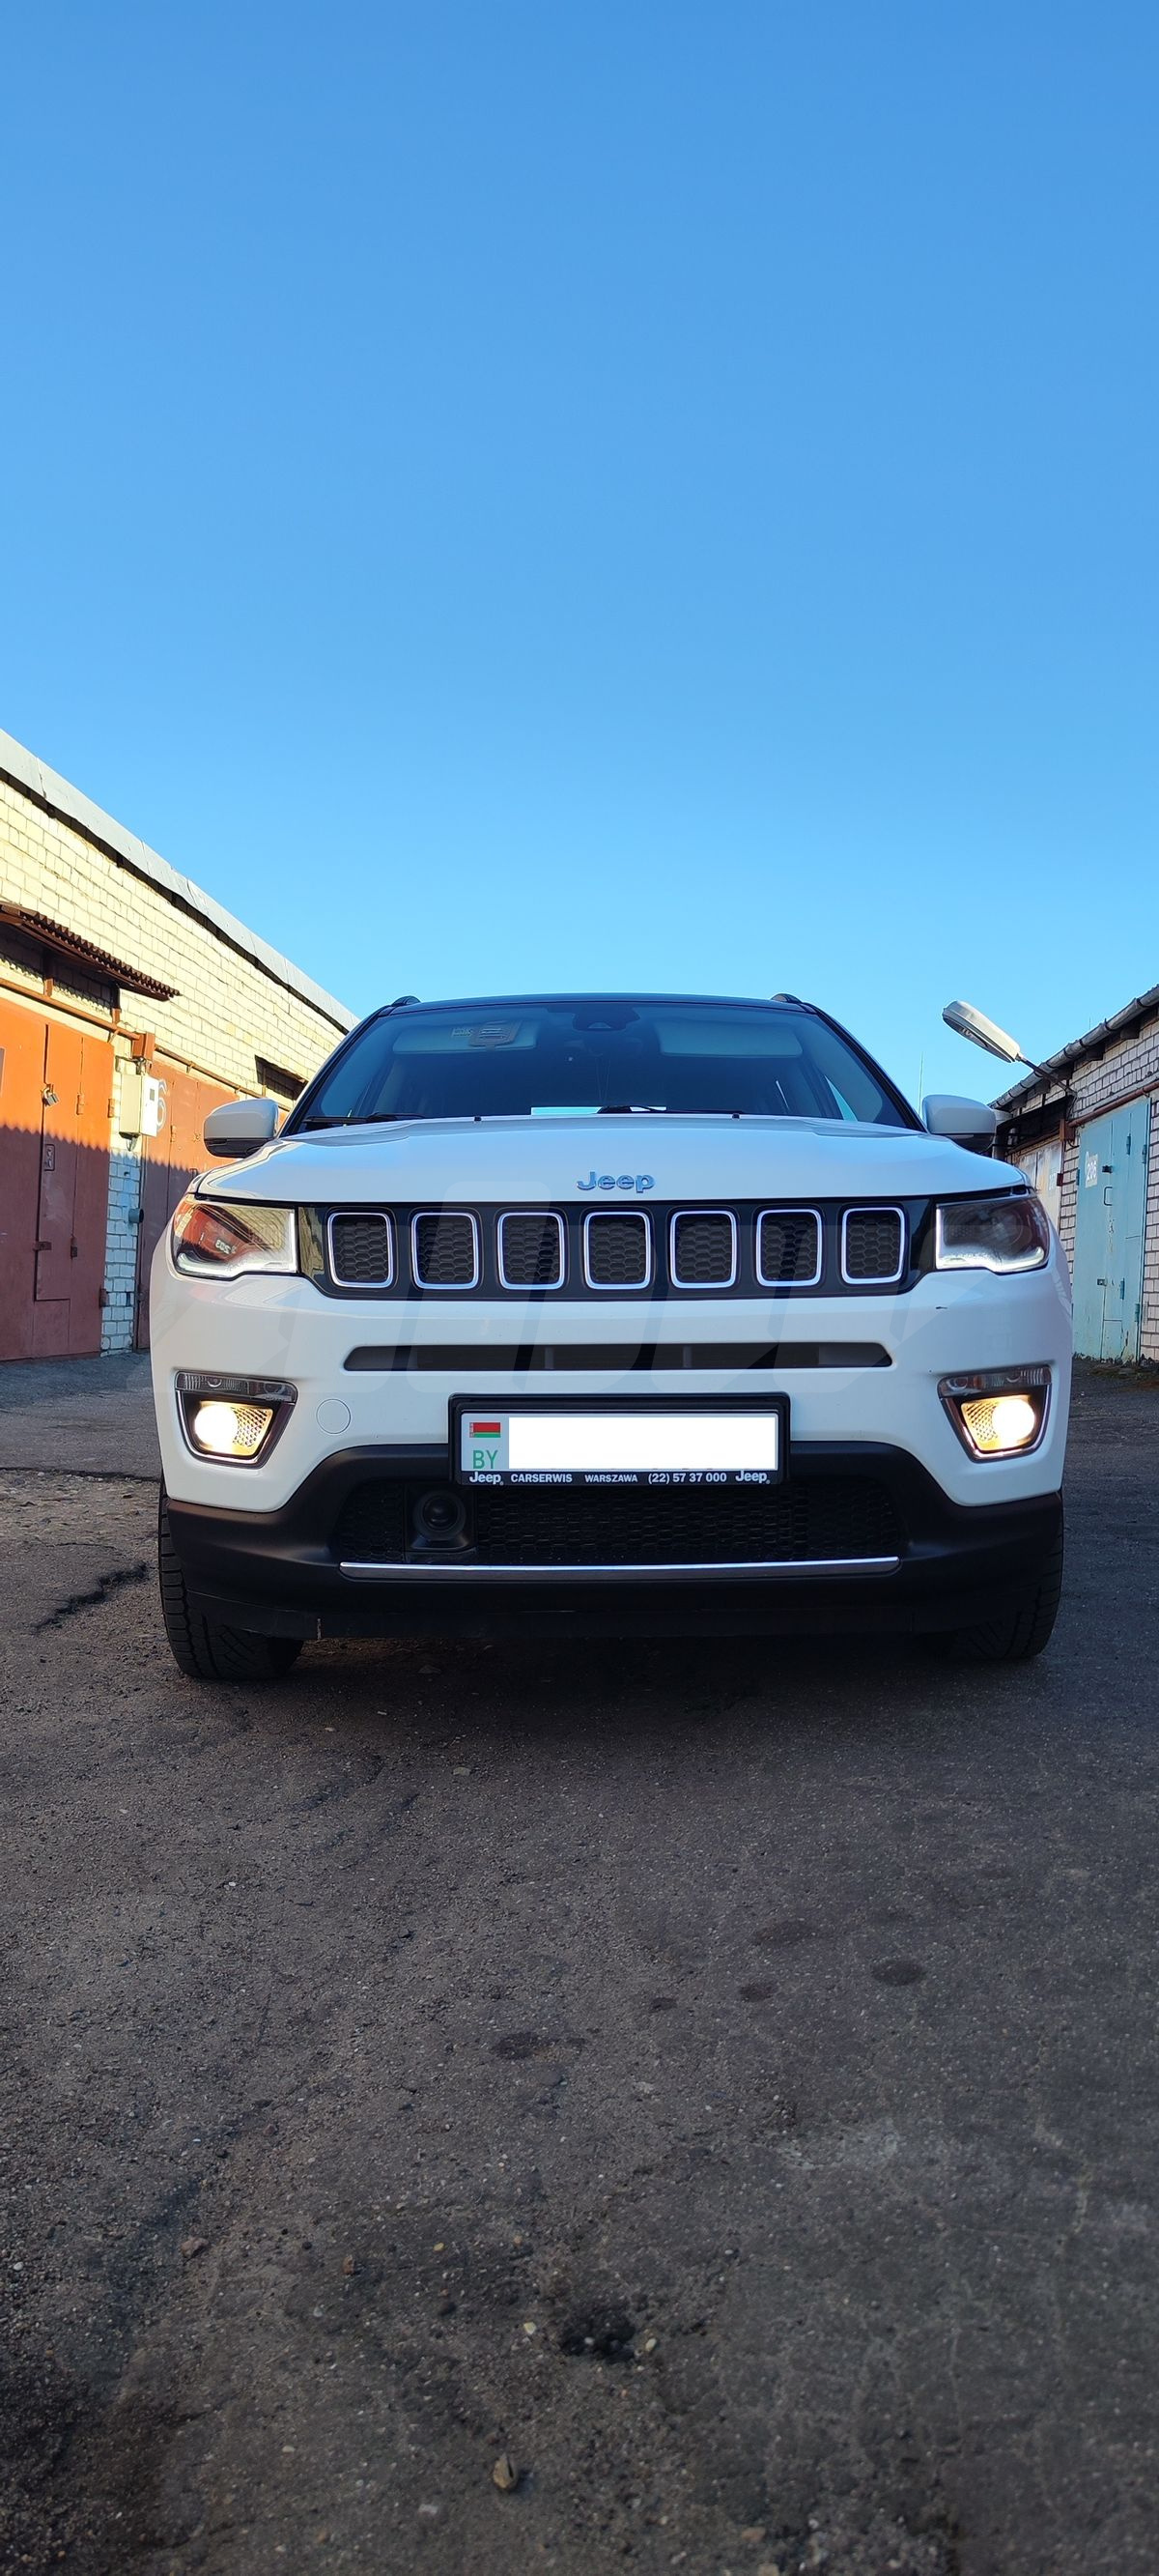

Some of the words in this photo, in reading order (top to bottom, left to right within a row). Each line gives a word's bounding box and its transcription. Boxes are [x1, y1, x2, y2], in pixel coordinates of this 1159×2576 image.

[577, 1170, 656, 1193] Jeep
[472, 1449, 498, 1470] BY
[468, 1471, 502, 1485] Jeep
[510, 1473, 573, 1483] CARSERWIS
[584, 1474, 638, 1483] WARSZAWA
[648, 1473, 670, 1485] (22)
[672, 1473, 687, 1483] 57
[689, 1473, 703, 1483] 37
[705, 1473, 727, 1483] 000
[735, 1470, 769, 1484] Jeep
